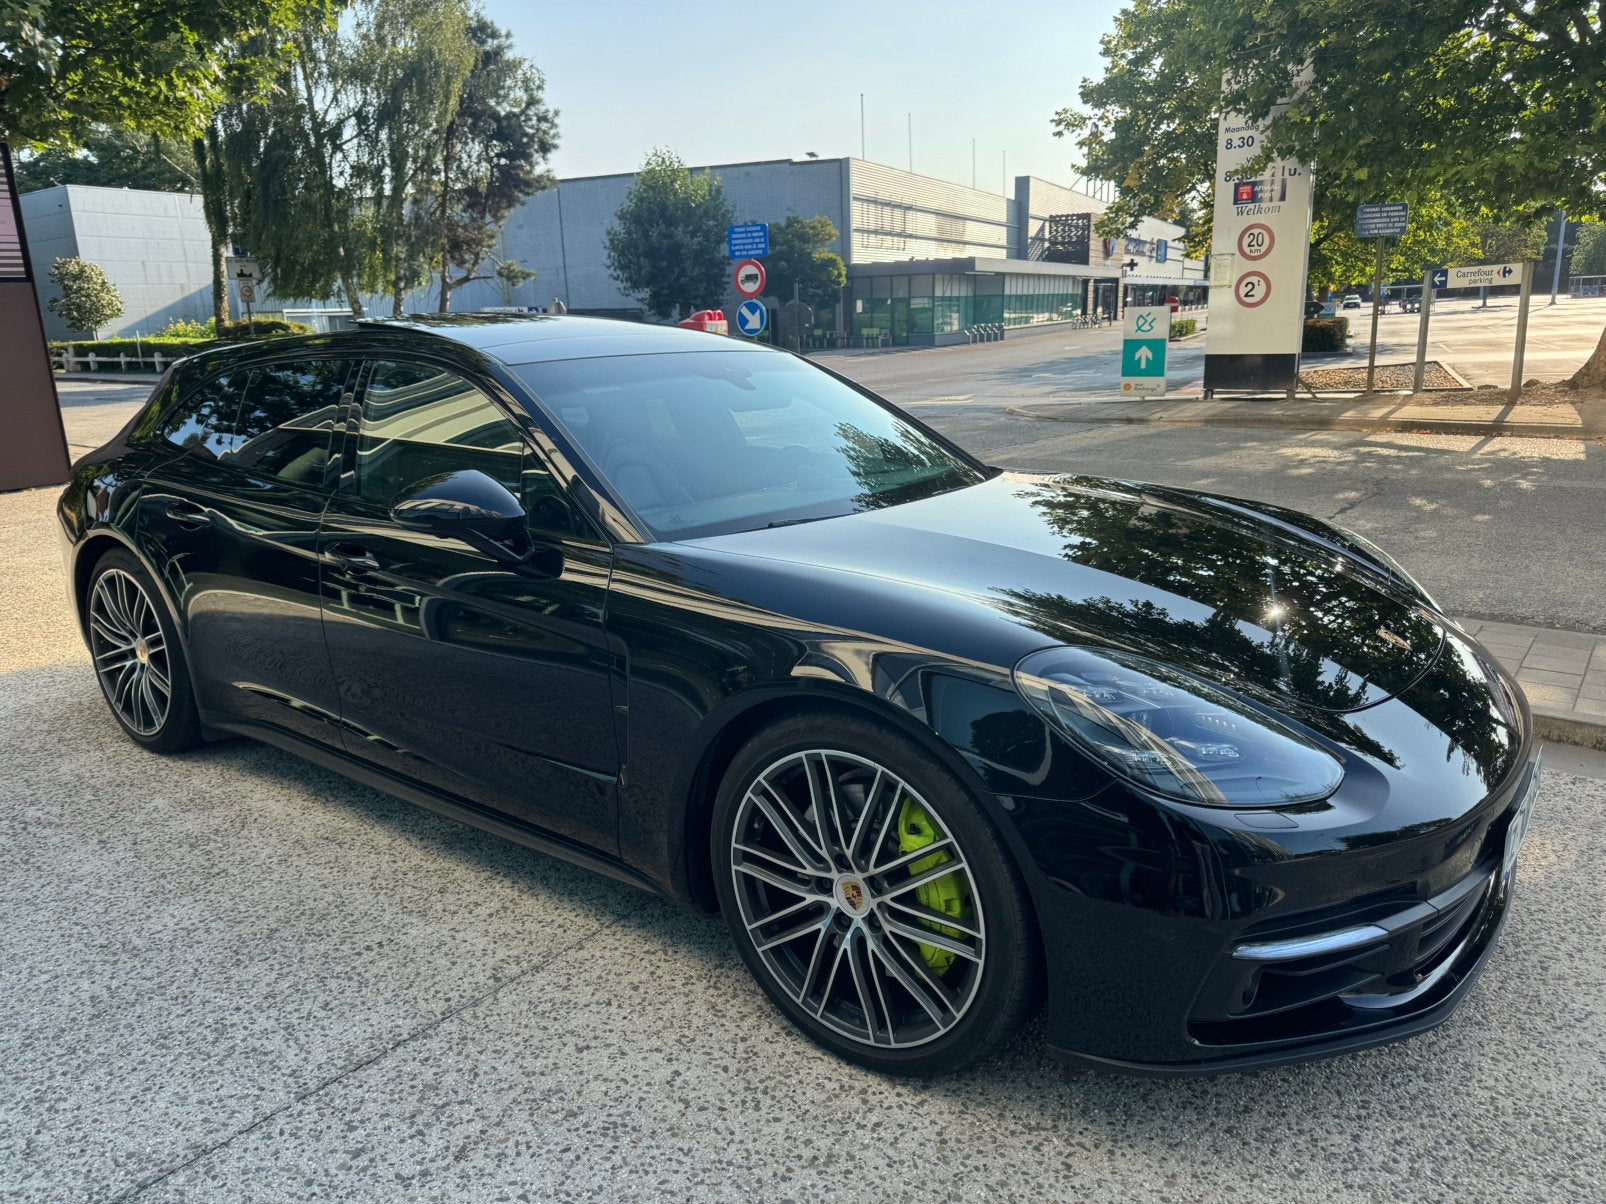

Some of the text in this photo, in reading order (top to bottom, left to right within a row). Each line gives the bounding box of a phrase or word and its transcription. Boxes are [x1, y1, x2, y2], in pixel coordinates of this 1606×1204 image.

[1224, 124, 1260, 134] Maandag
[1225, 135, 1255, 150] 8.30
[1236, 205, 1281, 216] Welkom
[1248, 232, 1265, 247] 20
[1456, 268, 1494, 278] Carrefour
[1468, 277, 1493, 286] parking
